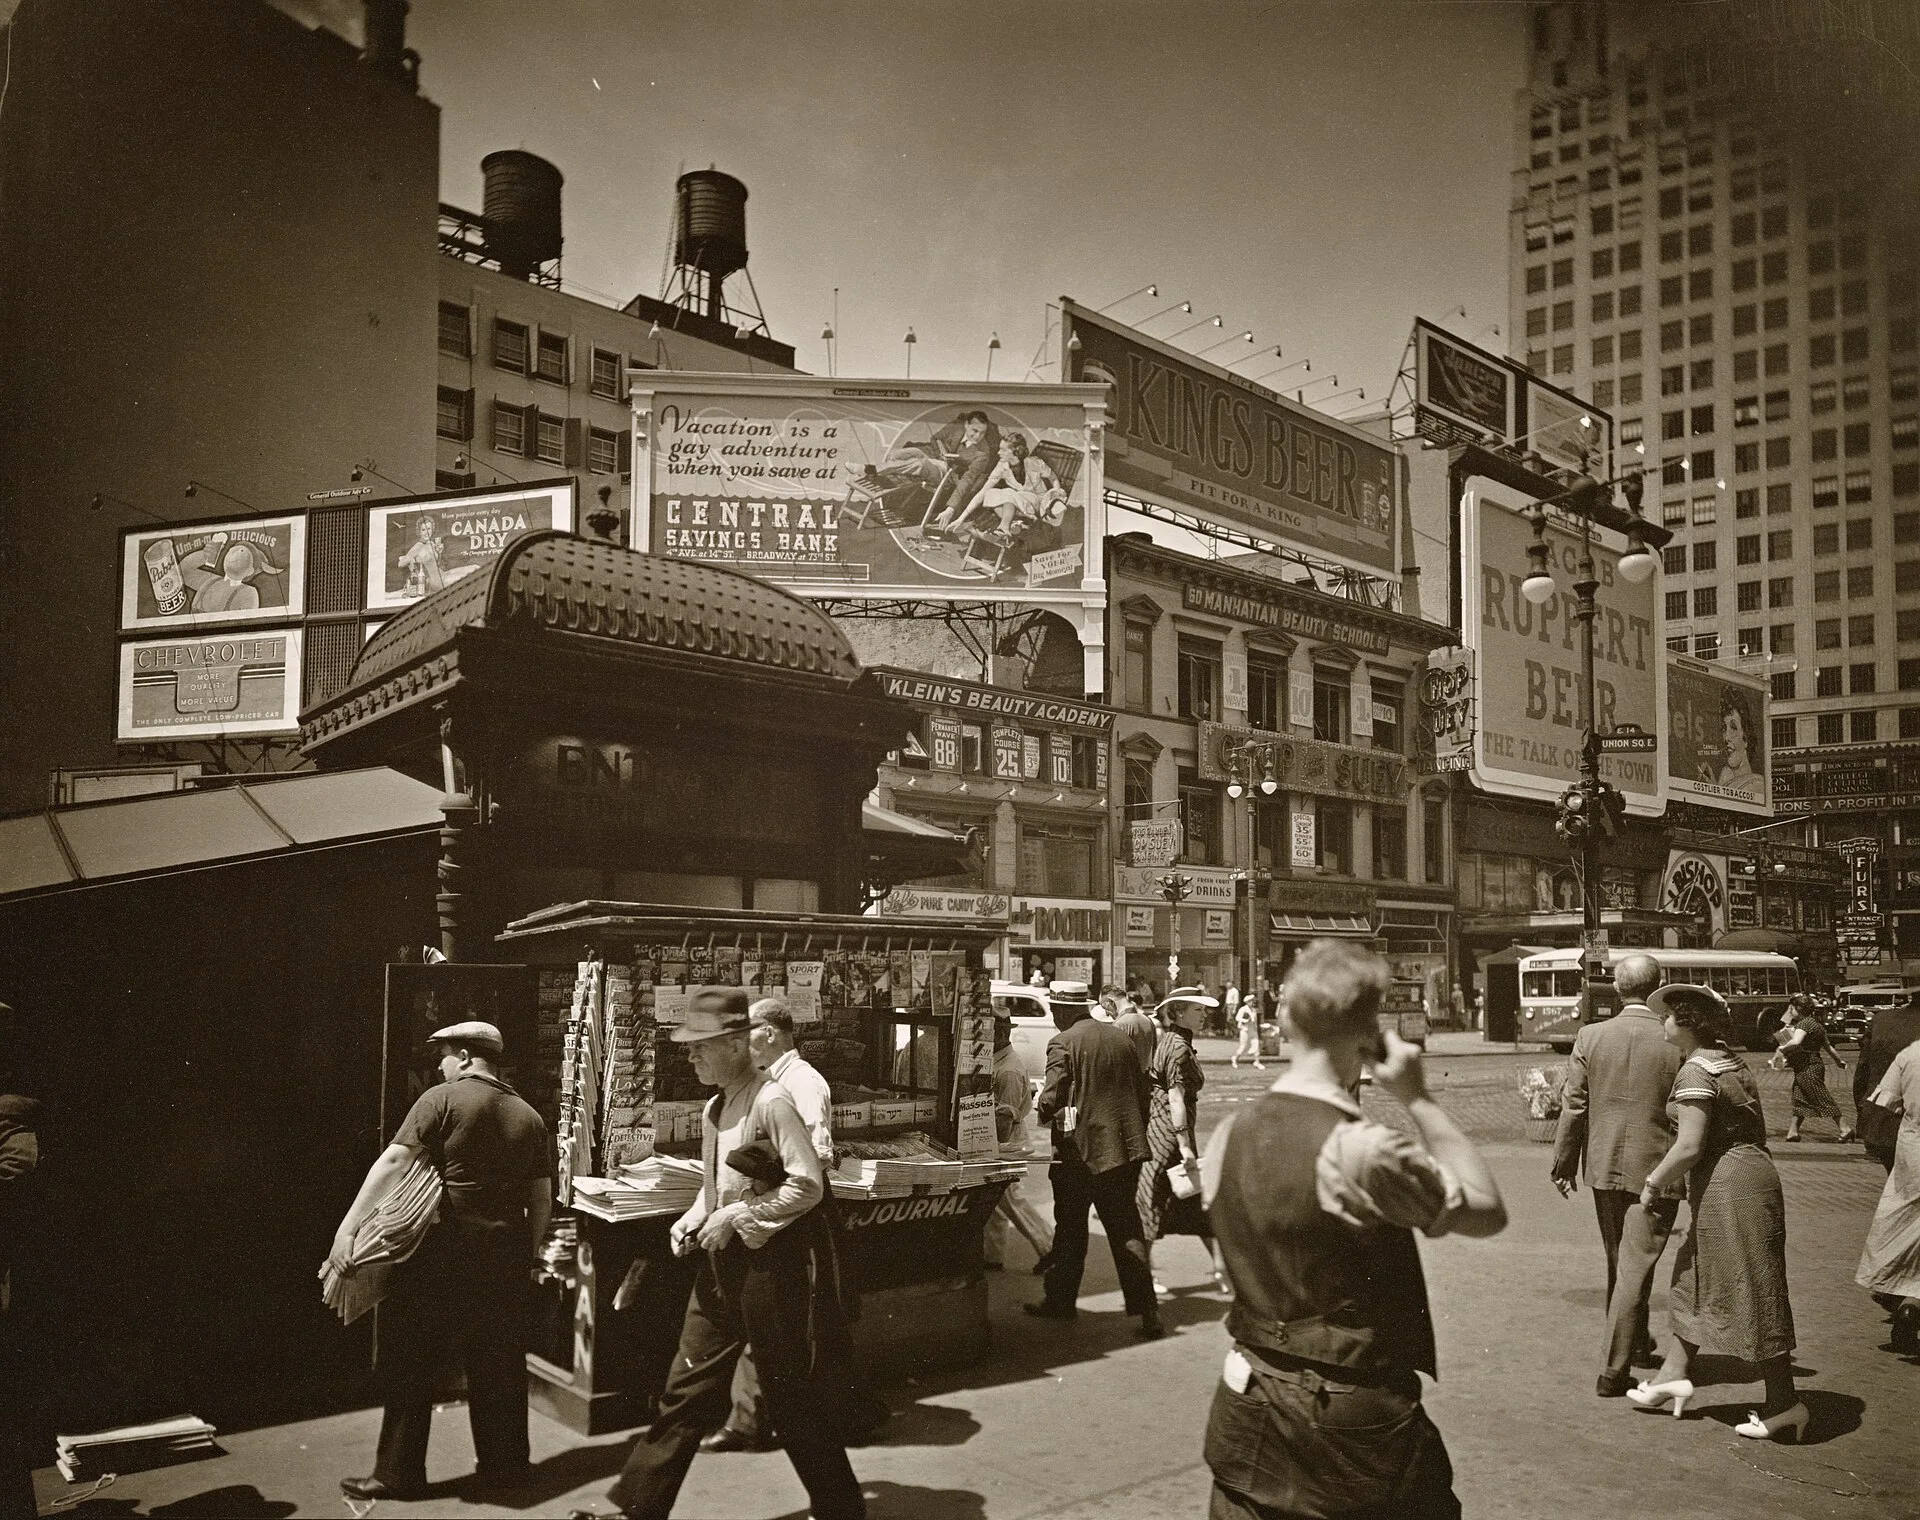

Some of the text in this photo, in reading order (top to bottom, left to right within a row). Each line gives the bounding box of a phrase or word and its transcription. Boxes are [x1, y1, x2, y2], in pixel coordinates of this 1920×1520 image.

[660, 405, 838, 438] Vacation is a
[1127, 353, 1255, 479] KINGS
[1262, 410, 1361, 521] BEER
[668, 438, 838, 463] gay adventure
[668, 458, 838, 482] when you save at
[1190, 478, 1302, 527] FIT FOR A KING
[667, 500, 838, 529] CENTRAL
[451, 513, 527, 536] CANADA
[230, 531, 277, 548] DELICIOUS
[470, 532, 509, 550] DRY
[665, 529, 838, 552] SAVINGS BANK
[746, 551, 796, 560] BROADWAY
[150, 554, 176, 583] Pabst
[158, 591, 186, 612] BEER
[1204, 591, 1279, 626] MANHATTAN
[1282, 611, 1329, 637] BEAUTY
[1332, 623, 1375, 650] SCHOOL
[1480, 563, 1650, 672] RUPPERT
[138, 640, 283, 669] CHEVROLET
[197, 673, 220, 681] MORE
[190, 682, 226, 692] QUALITY
[180, 695, 235, 707] MORE VALUE
[888, 678, 1111, 728] KLEIN'S BEAUTY ACADEMY
[1225, 694, 1247, 709] WAVE
[174, 715, 211, 723] COMPLETE
[215, 712, 262, 721] LOW-PRICED
[936, 731, 956, 739] WAVE
[992, 728, 1022, 742] COMPLETE
[994, 739, 1021, 750] COURSE
[1602, 738, 1655, 749] UNION SQ. E.
[1483, 731, 1516, 760] THE
[1521, 739, 1560, 768] TALK
[1616, 758, 1655, 786] TOWN
[1828, 772, 1868, 780] COLLEGE
[1828, 779, 1869, 787] CULTURE
[1693, 782, 1721, 794] COSTLIER
[1823, 800, 1833, 810] A
[1838, 796, 1887, 808] PROFIT
[1892, 796, 1906, 805] IN
[1196, 885, 1231, 897] DRINKS
[1856, 856, 1868, 911] FURS
[920, 896, 944, 911] PURE
[947, 898, 975, 912] CANDY
[788, 965, 821, 974] SPORT
[1060, 959, 1087, 968] SALE
[1542, 1007, 1563, 1015] 1567
[614, 1133, 655, 1143] DETECTIVE
[857, 1194, 970, 1227] JOURNAL
